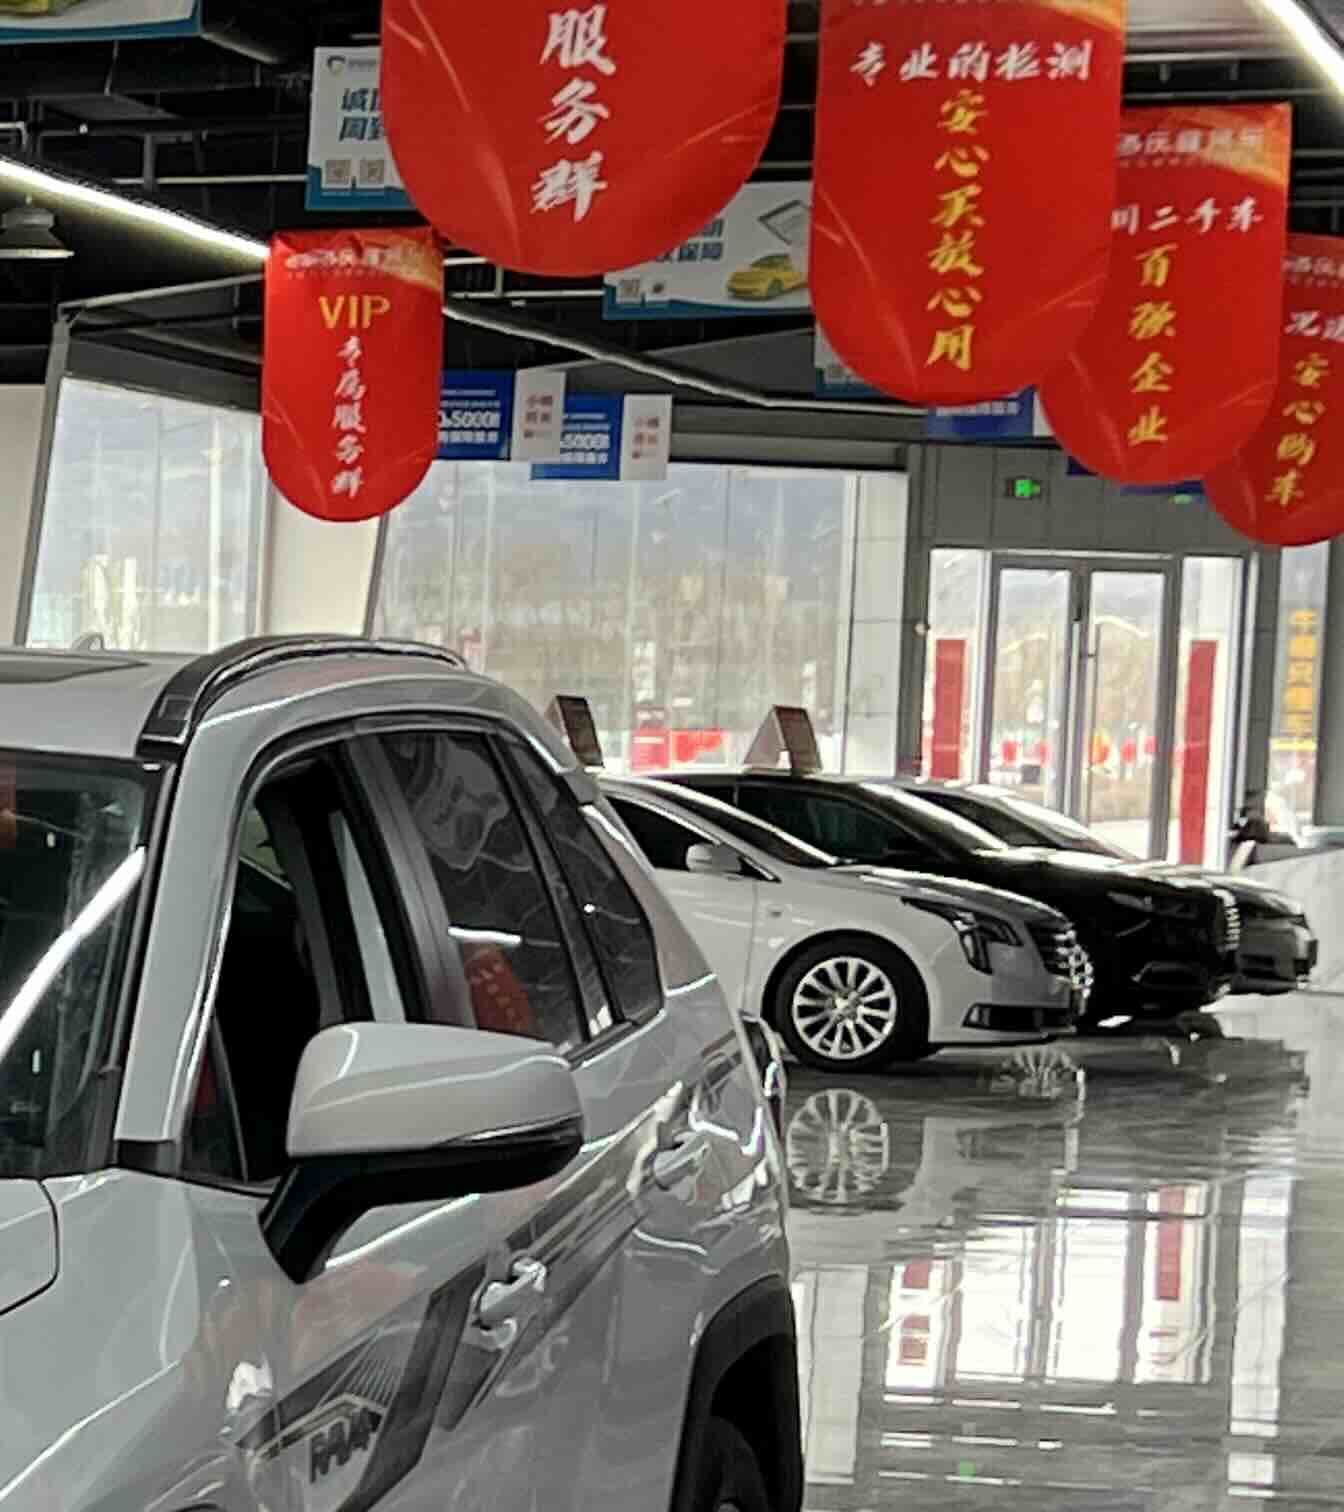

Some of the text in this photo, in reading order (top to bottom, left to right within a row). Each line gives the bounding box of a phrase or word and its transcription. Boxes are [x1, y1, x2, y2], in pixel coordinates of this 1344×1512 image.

[531, 4, 617, 222] 服务群
[850, 39, 1094, 87] 专业的检测
[318, 294, 391, 329] VIP
[1127, 243, 1178, 447] 百强企业
